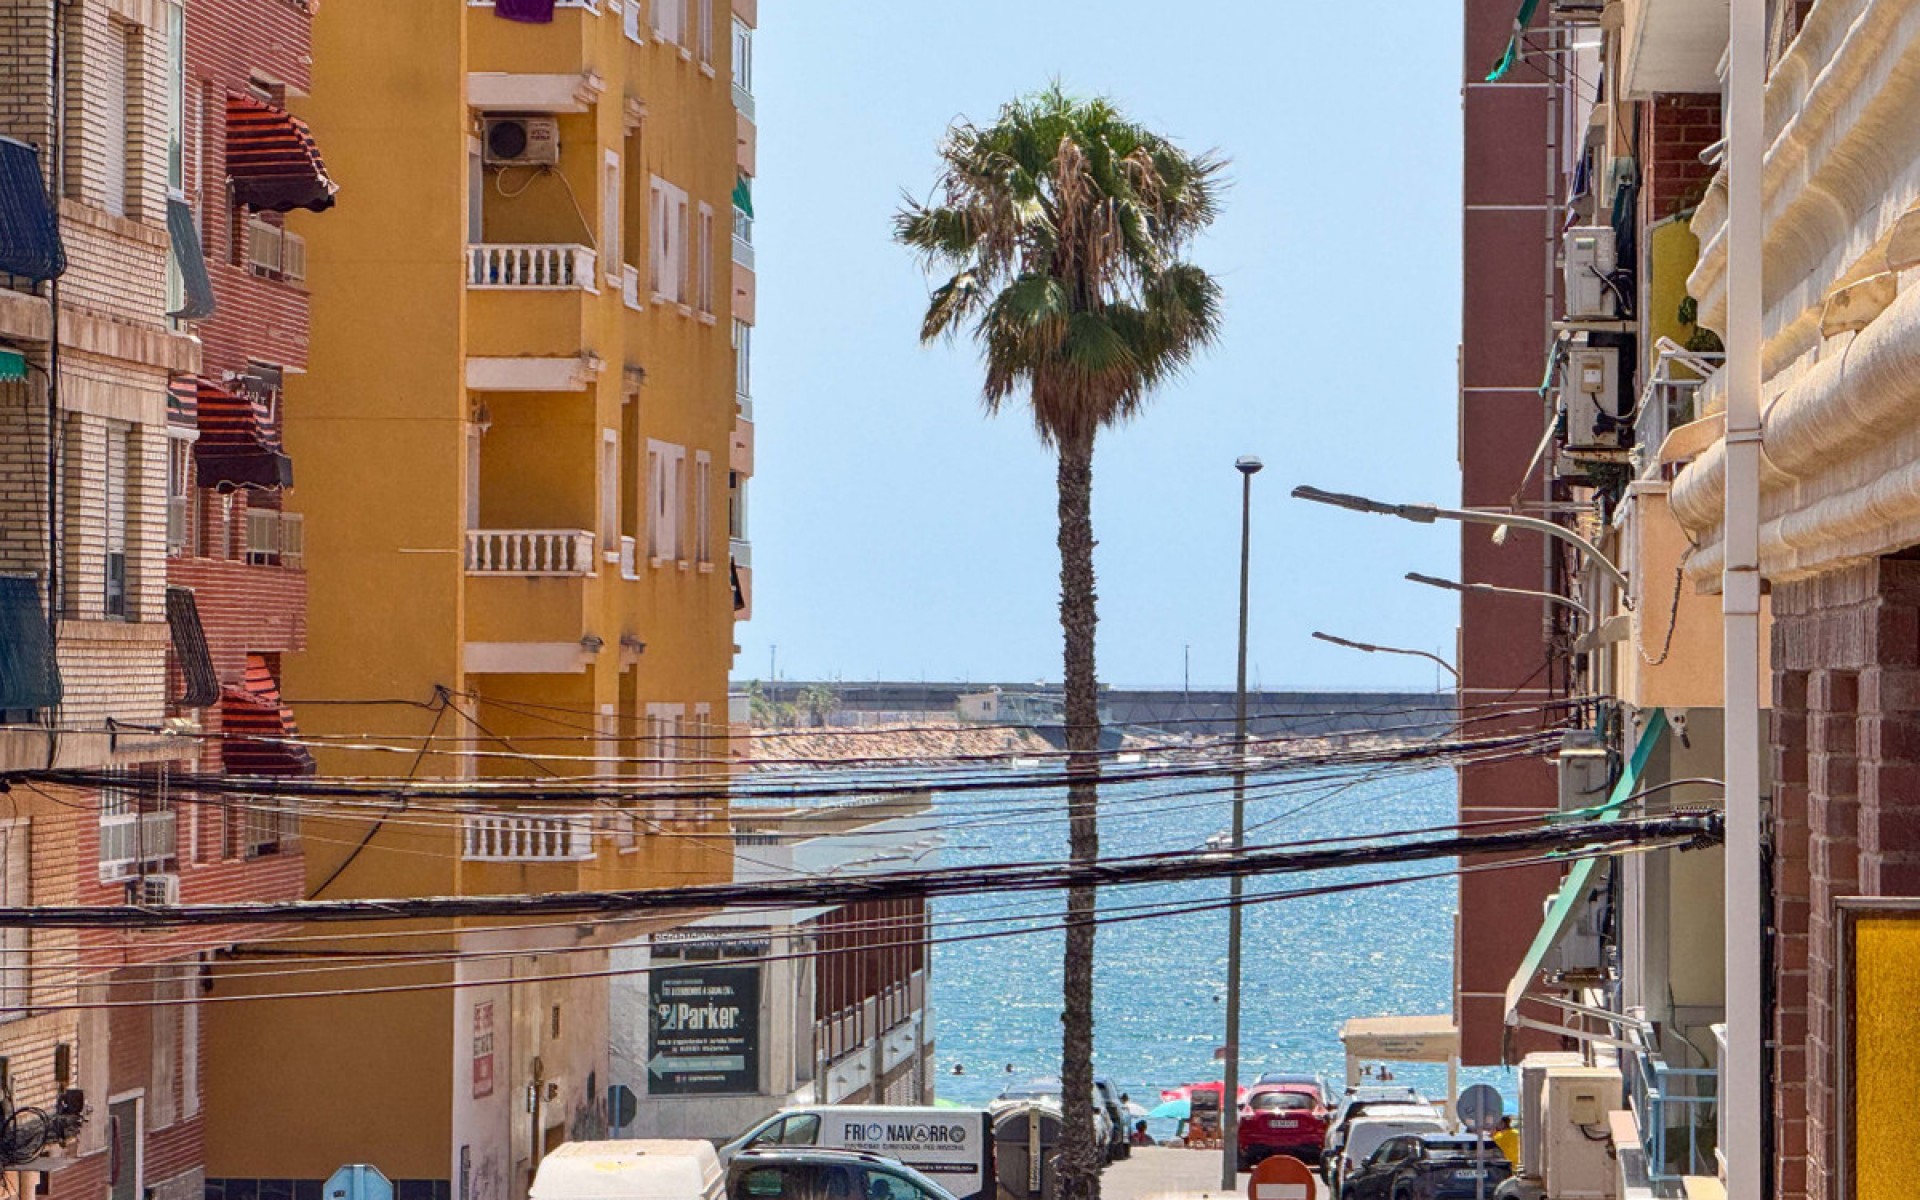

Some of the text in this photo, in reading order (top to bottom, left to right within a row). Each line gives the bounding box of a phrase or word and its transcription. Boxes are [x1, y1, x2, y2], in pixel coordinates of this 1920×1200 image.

[678, 1002, 740, 1030] Parker
[844, 1122, 966, 1143] FRIO NAVARRO
